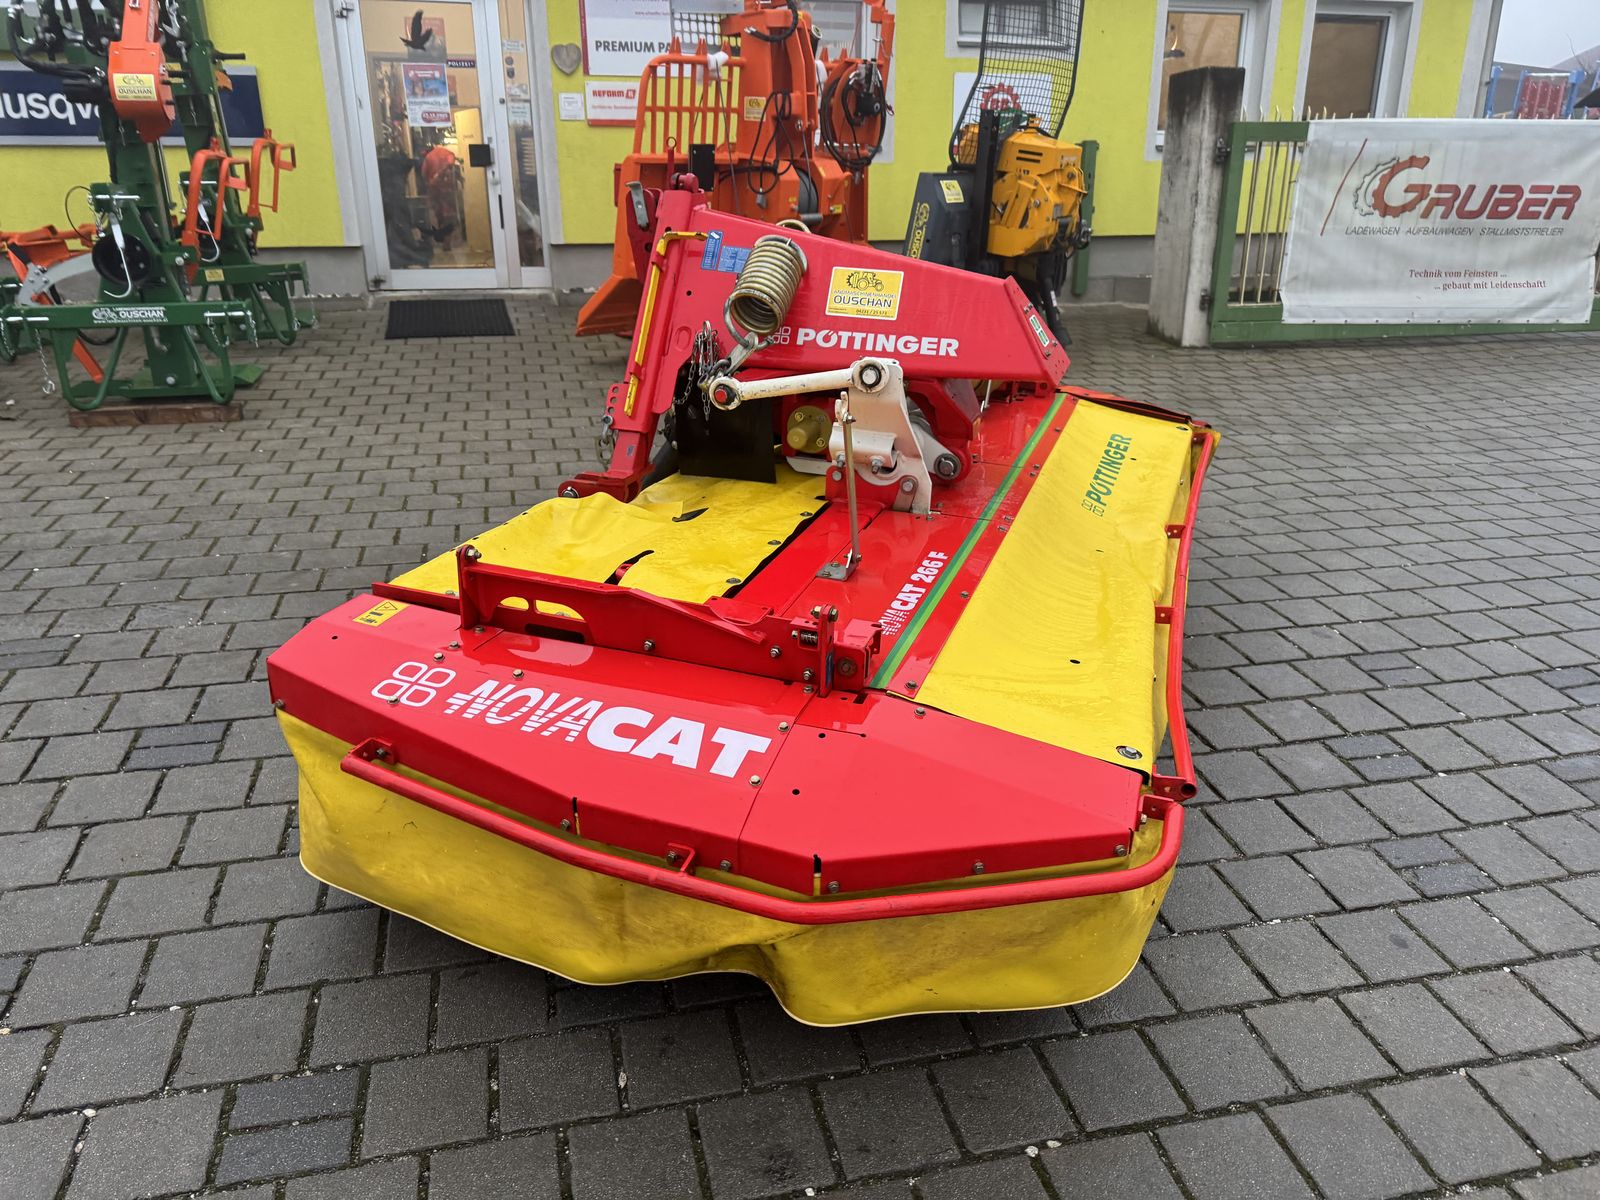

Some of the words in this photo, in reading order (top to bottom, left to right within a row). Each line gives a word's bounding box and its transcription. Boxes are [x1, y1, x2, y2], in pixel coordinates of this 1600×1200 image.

[594, 40, 656, 53] PREMIUM
[592, 89, 625, 98] REFORM
[0, 93, 100, 125] usqv
[1372, 155, 1582, 219] GRUBER
[1344, 227, 1400, 236] LADEWAGEN
[1406, 227, 1474, 236] AUFBAUWAGEN
[1479, 227, 1565, 237] STALLMISTSTREUER
[1409, 269, 1443, 278] Technik
[1463, 269, 1498, 278] Feinsten
[1442, 281, 1471, 290] gebaut
[1473, 281, 1488, 289] mit
[1490, 280, 1546, 289] Leidenschaft!
[833, 294, 893, 308] OUSCHAN
[119, 310, 165, 319] OUSCHAN
[910, 559, 944, 584] 266
[927, 550, 949, 560] F
[443, 679, 773, 778] NOVACAT
